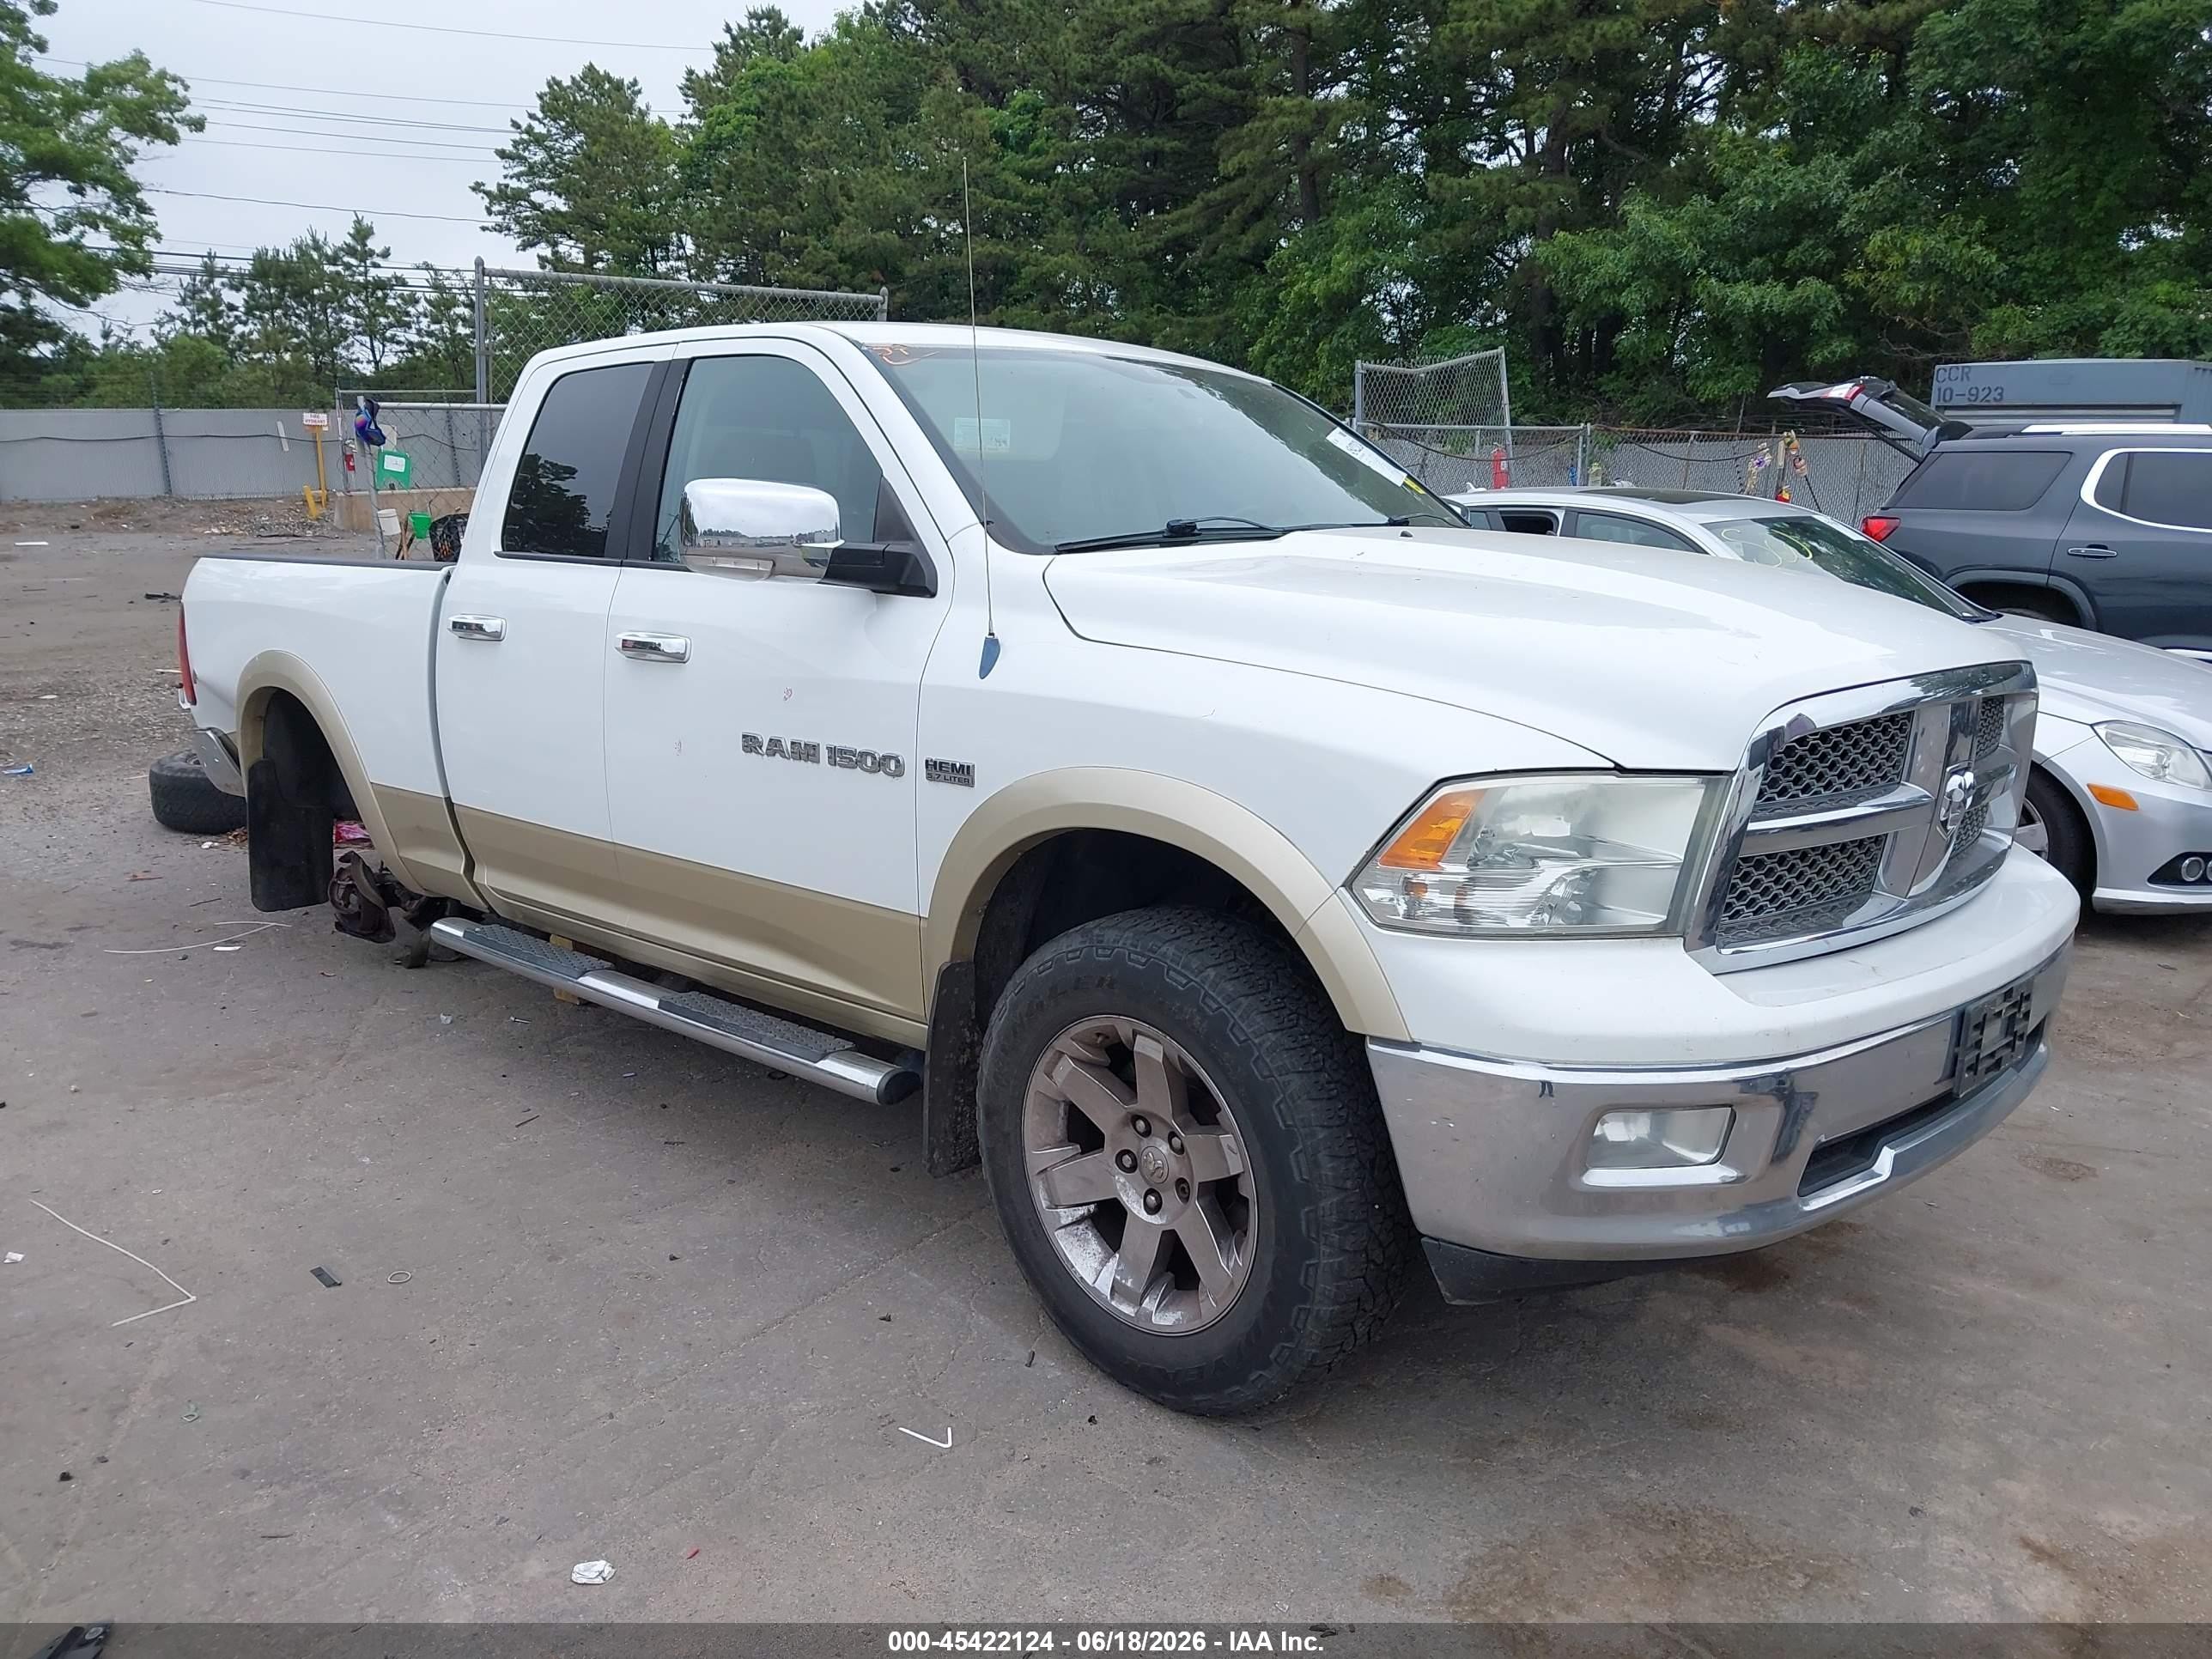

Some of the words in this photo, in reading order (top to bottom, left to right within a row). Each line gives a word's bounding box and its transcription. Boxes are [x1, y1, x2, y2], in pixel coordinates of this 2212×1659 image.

[1936, 366, 1971, 383] CCR
[1936, 386, 2004, 403] 10-923
[741, 732, 820, 763] RAM
[825, 744, 905, 777] 1500
[925, 758, 972, 775] HEMI
[943, 775, 970, 784] LITER
